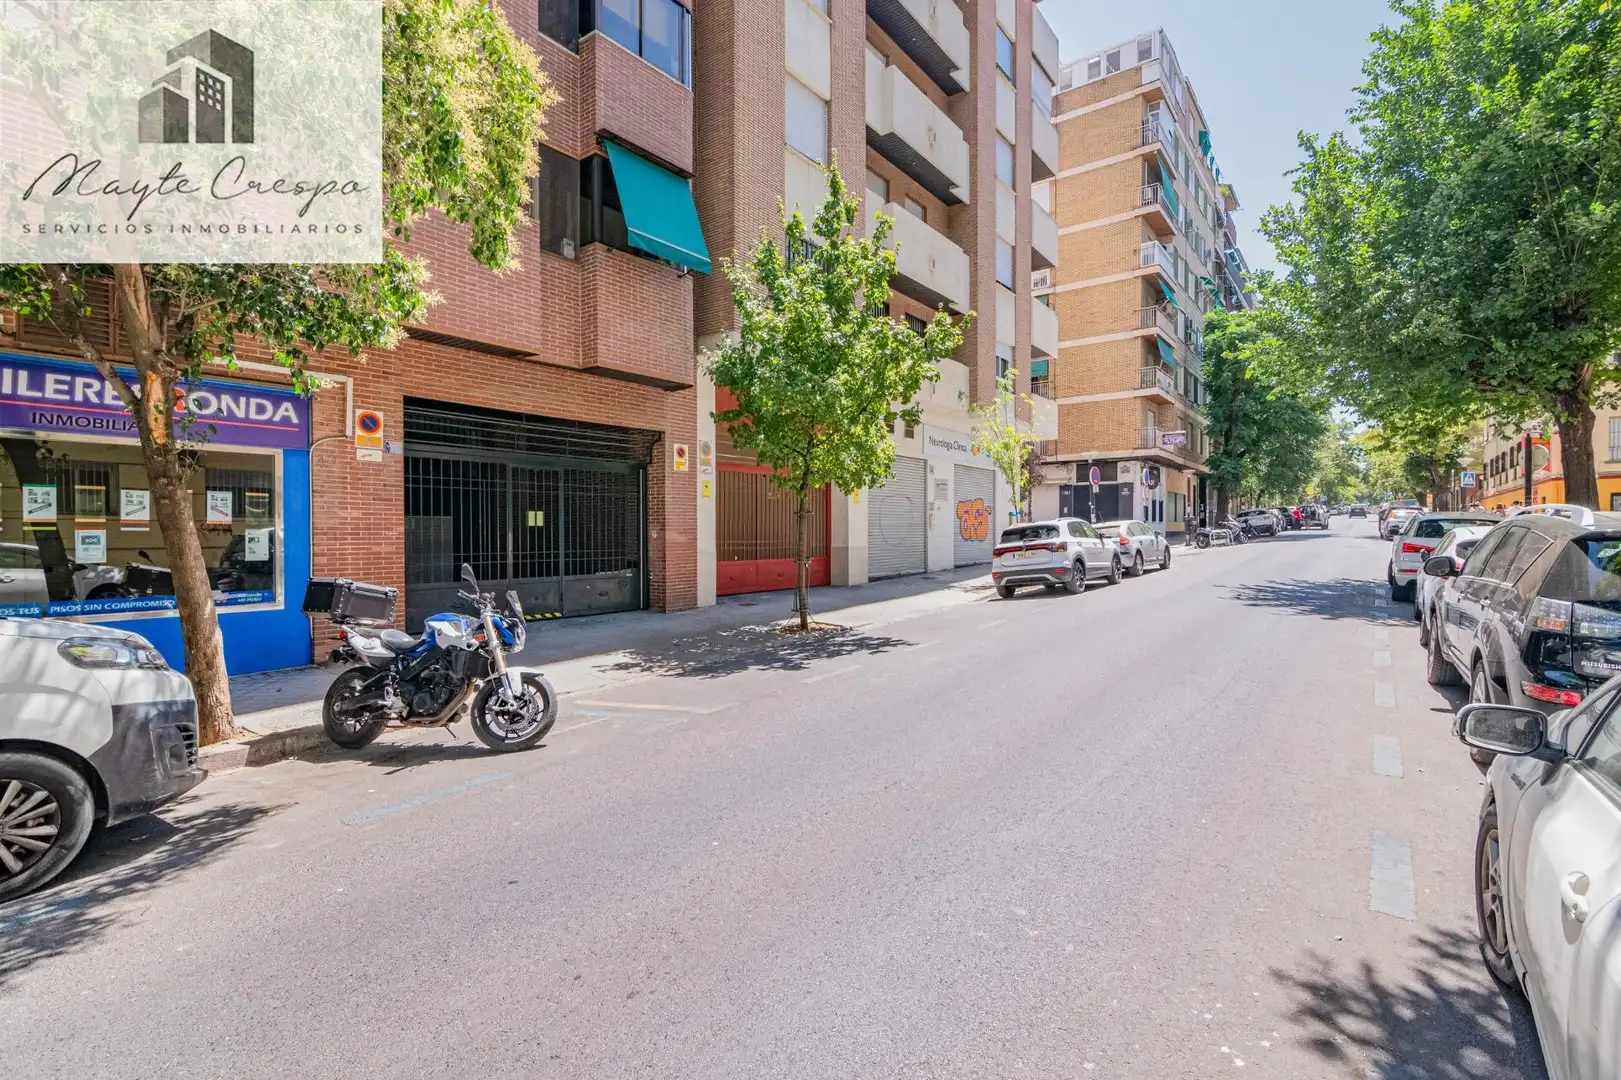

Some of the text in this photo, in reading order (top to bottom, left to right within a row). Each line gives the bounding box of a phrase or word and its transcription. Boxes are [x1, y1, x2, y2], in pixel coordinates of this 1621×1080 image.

[18, 607, 40, 615] TUS
[50, 600, 176, 613] PISOS SIN COMPROMISO
